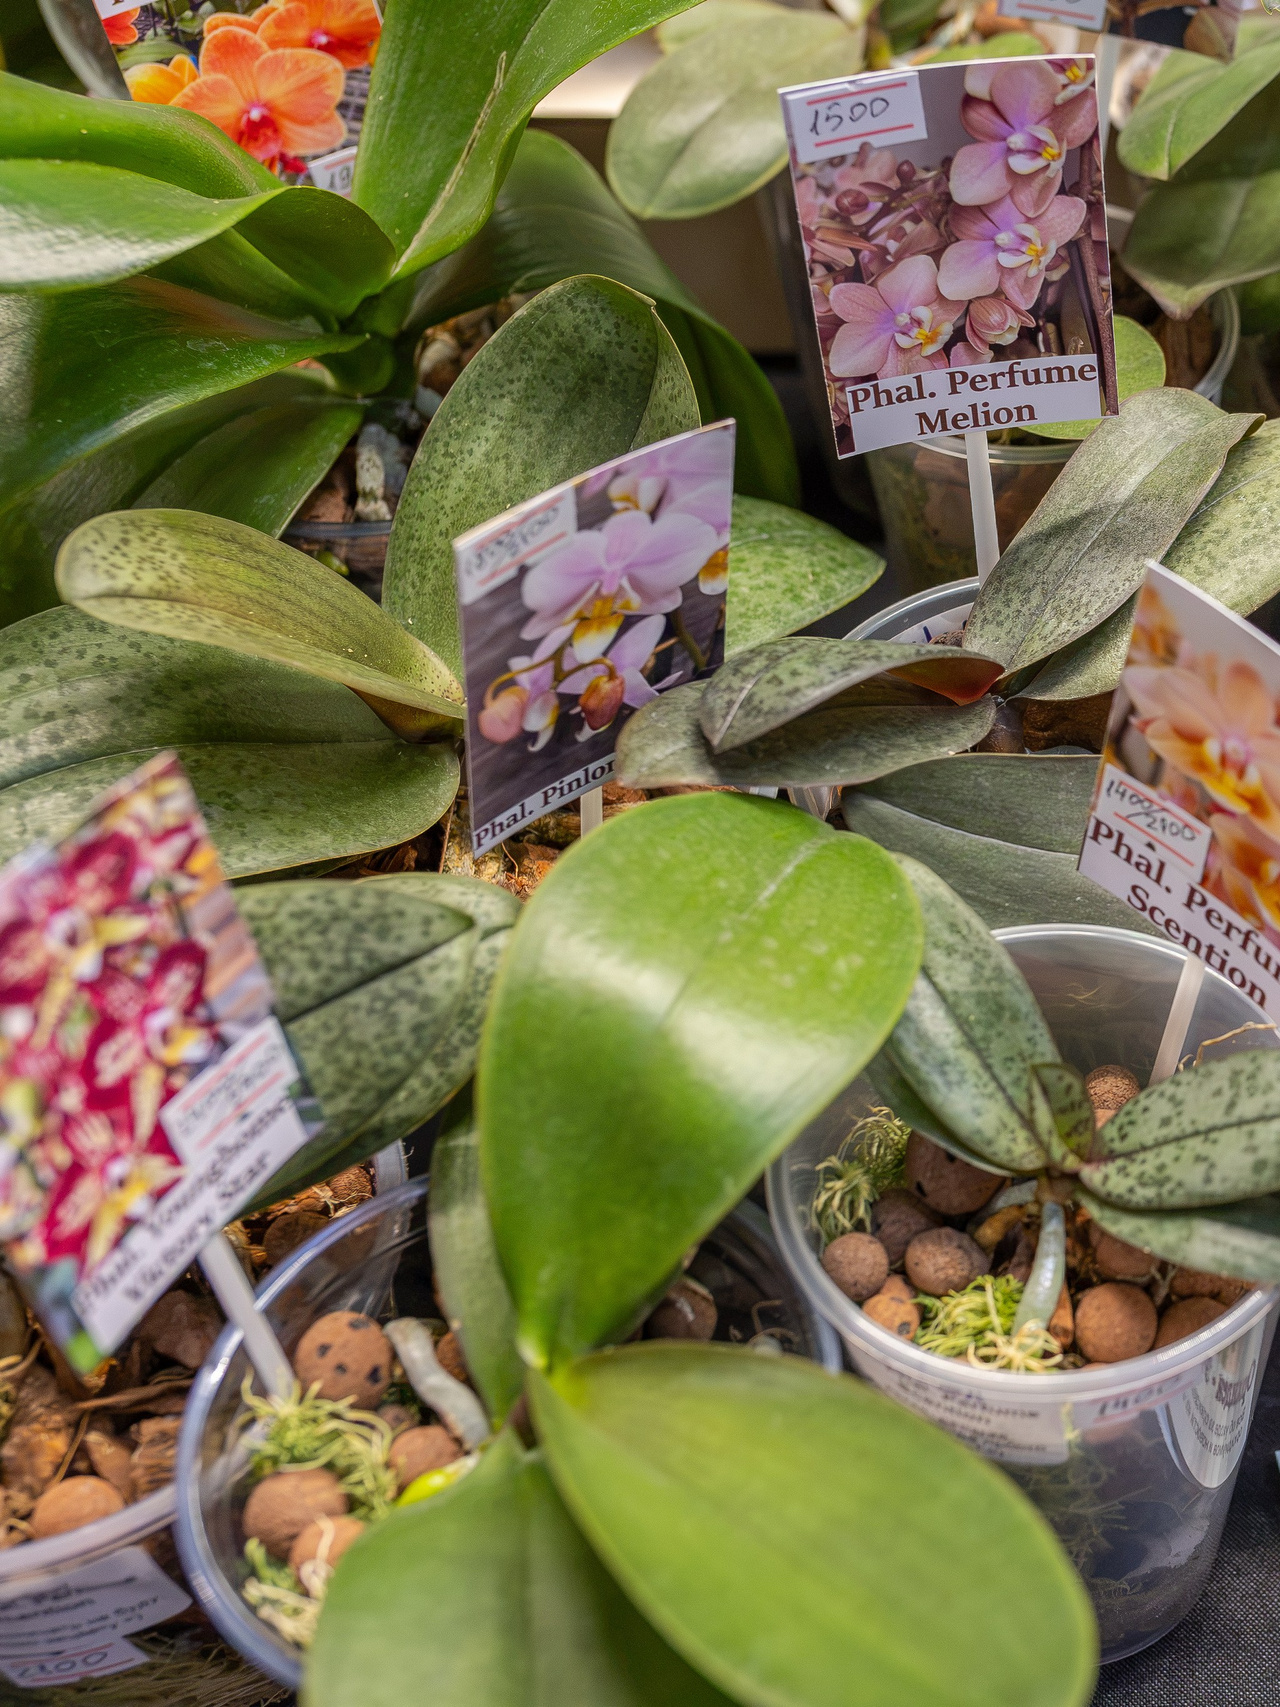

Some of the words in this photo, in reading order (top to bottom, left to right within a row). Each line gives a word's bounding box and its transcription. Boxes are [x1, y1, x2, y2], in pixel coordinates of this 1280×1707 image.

[809, 97, 890, 136] 1500
[848, 375, 937, 414] Phal.
[946, 361, 1098, 396] Perfume
[915, 401, 1038, 436] Melion
[474, 802, 535, 850] Phal.
[1088, 816, 1173, 894] Phal.
[1126, 883, 1269, 1010] Scention
